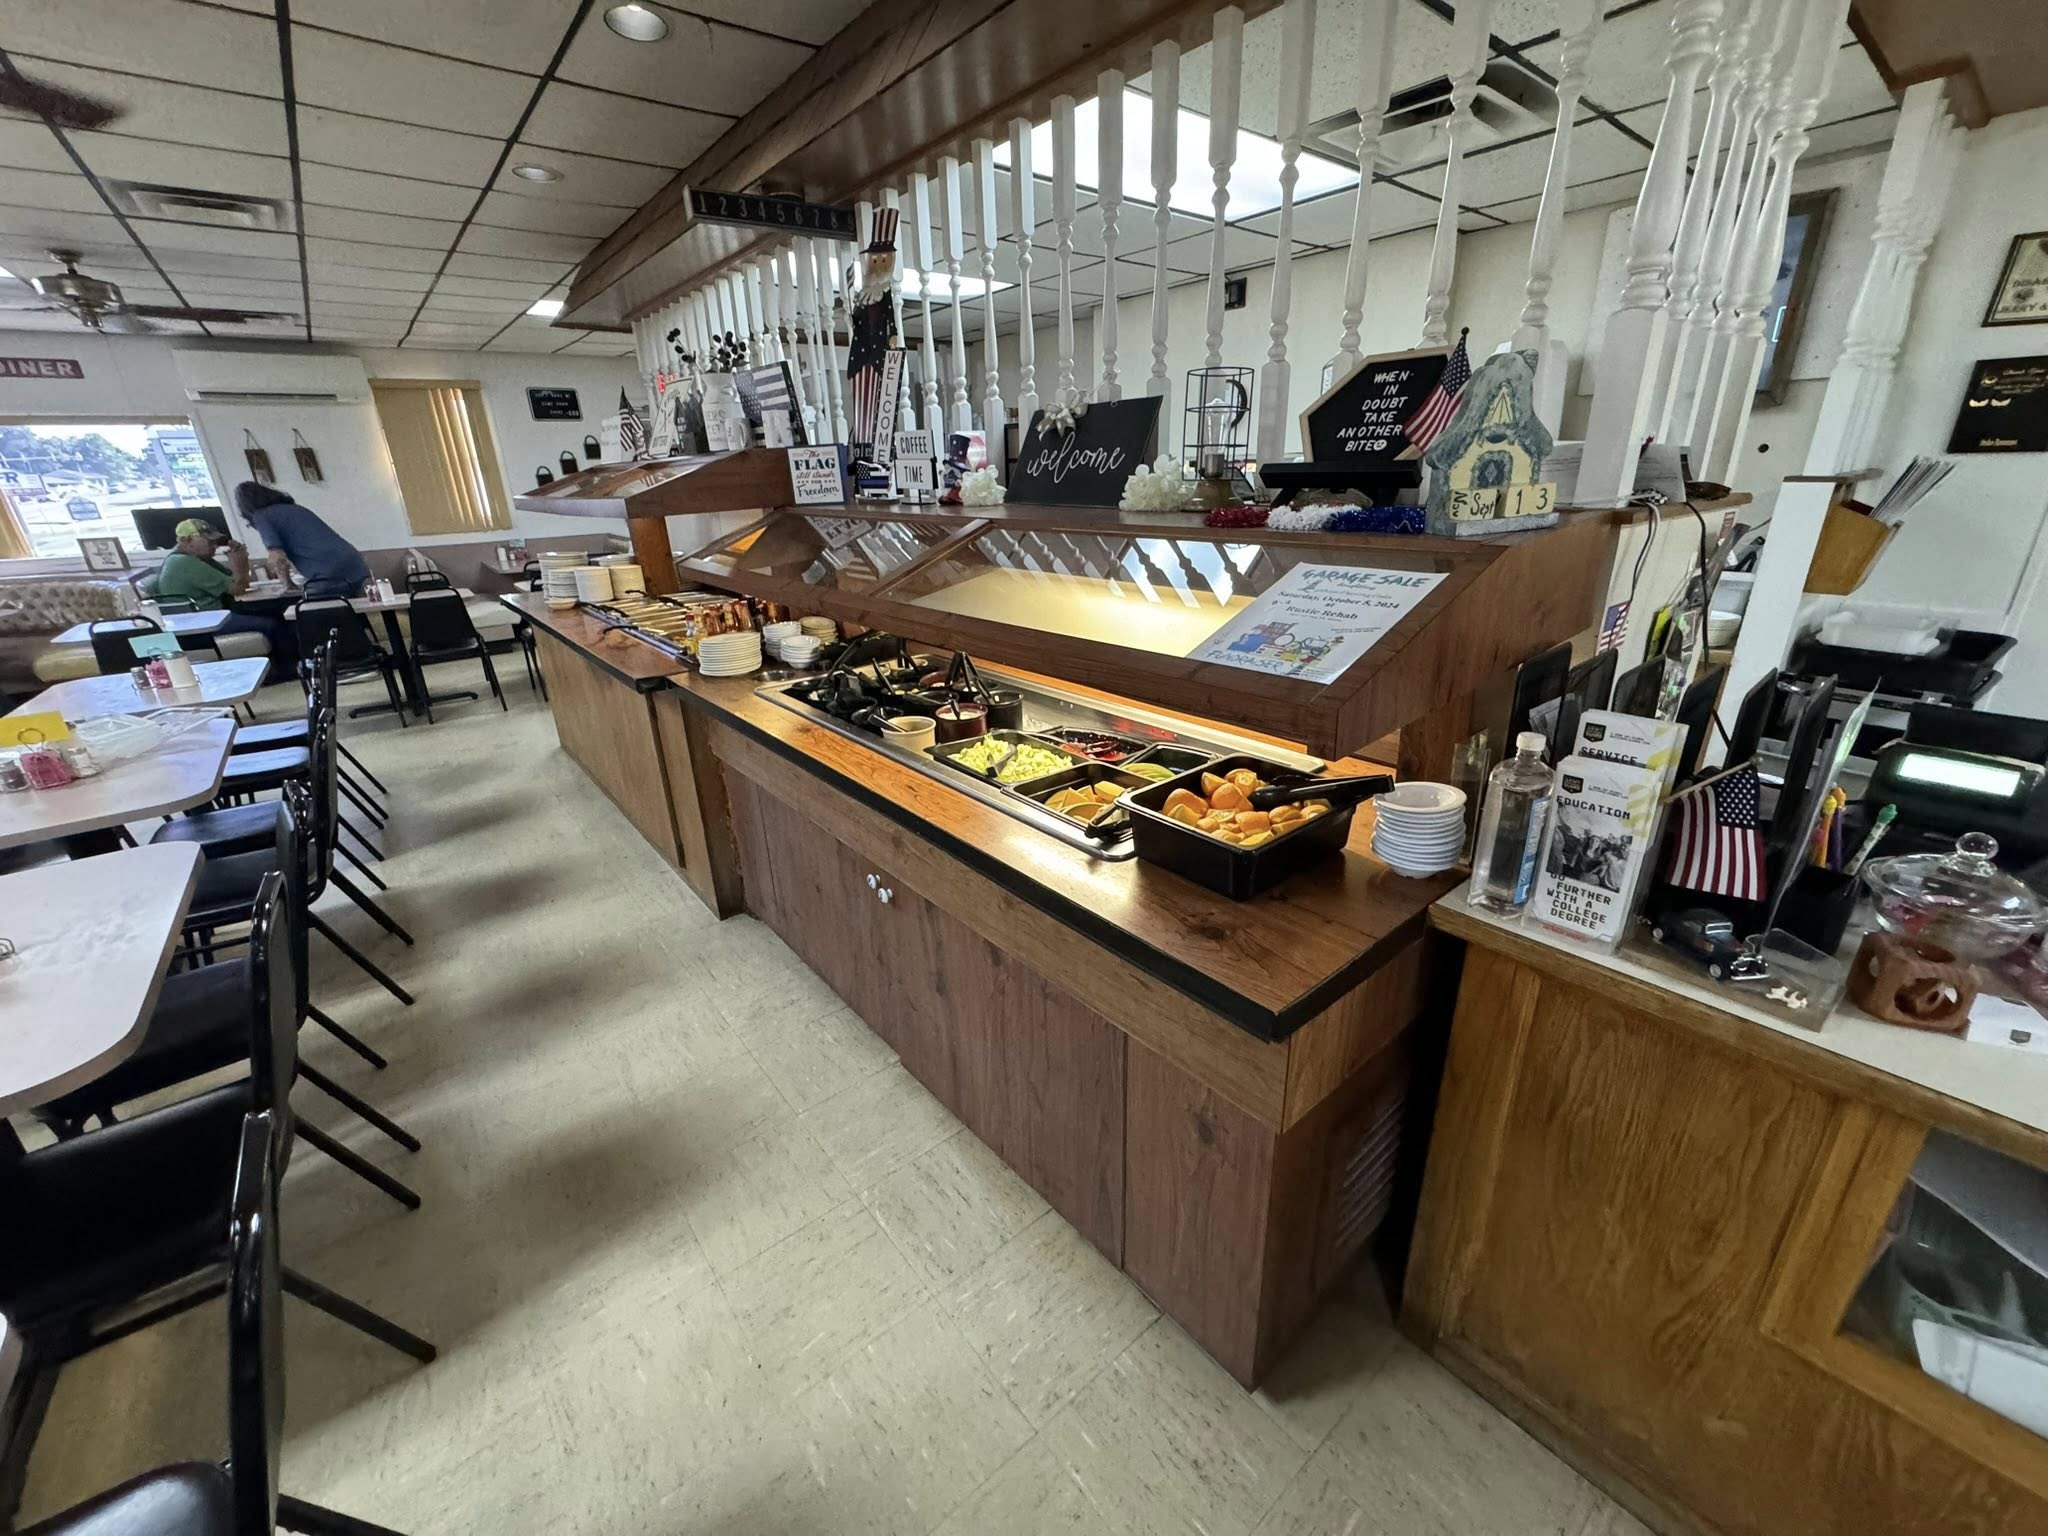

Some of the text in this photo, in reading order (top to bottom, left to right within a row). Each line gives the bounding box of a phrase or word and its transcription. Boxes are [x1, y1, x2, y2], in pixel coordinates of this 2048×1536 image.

[719, 196, 727, 215] 2
[739, 198, 747, 217] 3
[758, 201, 766, 221] 4
[777, 204, 785, 222] 5
[1374, 371, 1410, 384] WHEN
[1383, 384, 1399, 396] IN
[876, 352, 900, 464] WELCOME
[1362, 397, 1408, 410] DOUBT
[1364, 411, 1397, 423] TAKE
[1337, 425, 1402, 438] ANOTHER
[900, 436, 928, 455] COFFEE
[1345, 440, 1375, 452] BITE
[794, 457, 836, 470] FLAG
[1027, 432, 1125, 484] welcome
[904, 466, 924, 483] TIME
[797, 484, 839, 497] Freedom
[1515, 488, 1523, 515] 1
[1536, 487, 1548, 510] 3
[1302, 569, 1376, 584] GARAGE
[1374, 575, 1431, 588] SALE
[1322, 610, 1358, 619] Rehab
[1375, 601, 1400, 609] 2024
[1580, 746, 1638, 766] SERVICE
[1556, 795, 1631, 820] EDUCATION
[1546, 888, 1593, 909] WITH A
[1556, 881, 1612, 905] FURTHER
[1550, 908, 1597, 930] DEGREE
[1552, 899, 1607, 924] COLLEGE
